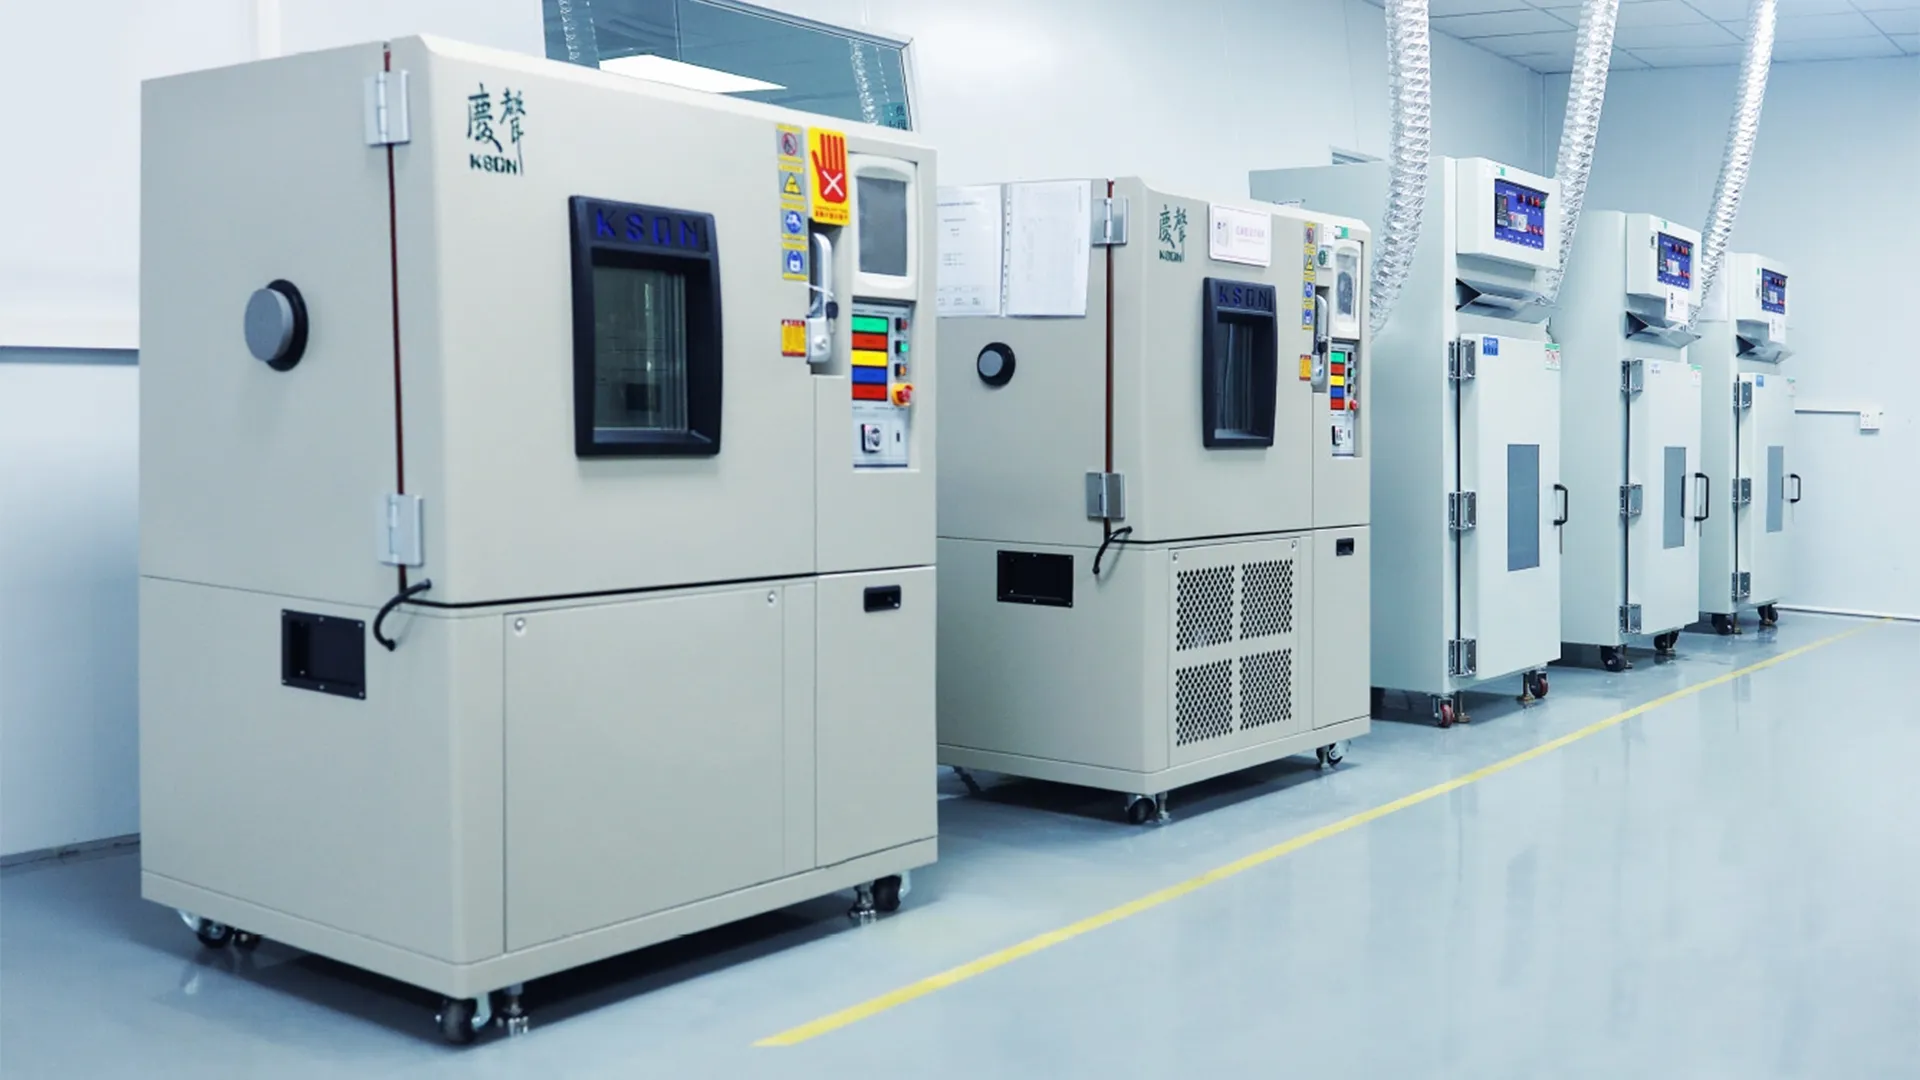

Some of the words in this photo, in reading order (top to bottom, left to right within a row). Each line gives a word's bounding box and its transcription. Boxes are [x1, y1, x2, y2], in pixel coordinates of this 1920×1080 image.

[470, 153, 518, 175] KSON
[596, 208, 700, 248] KSON
[1219, 285, 1267, 309] KSON
